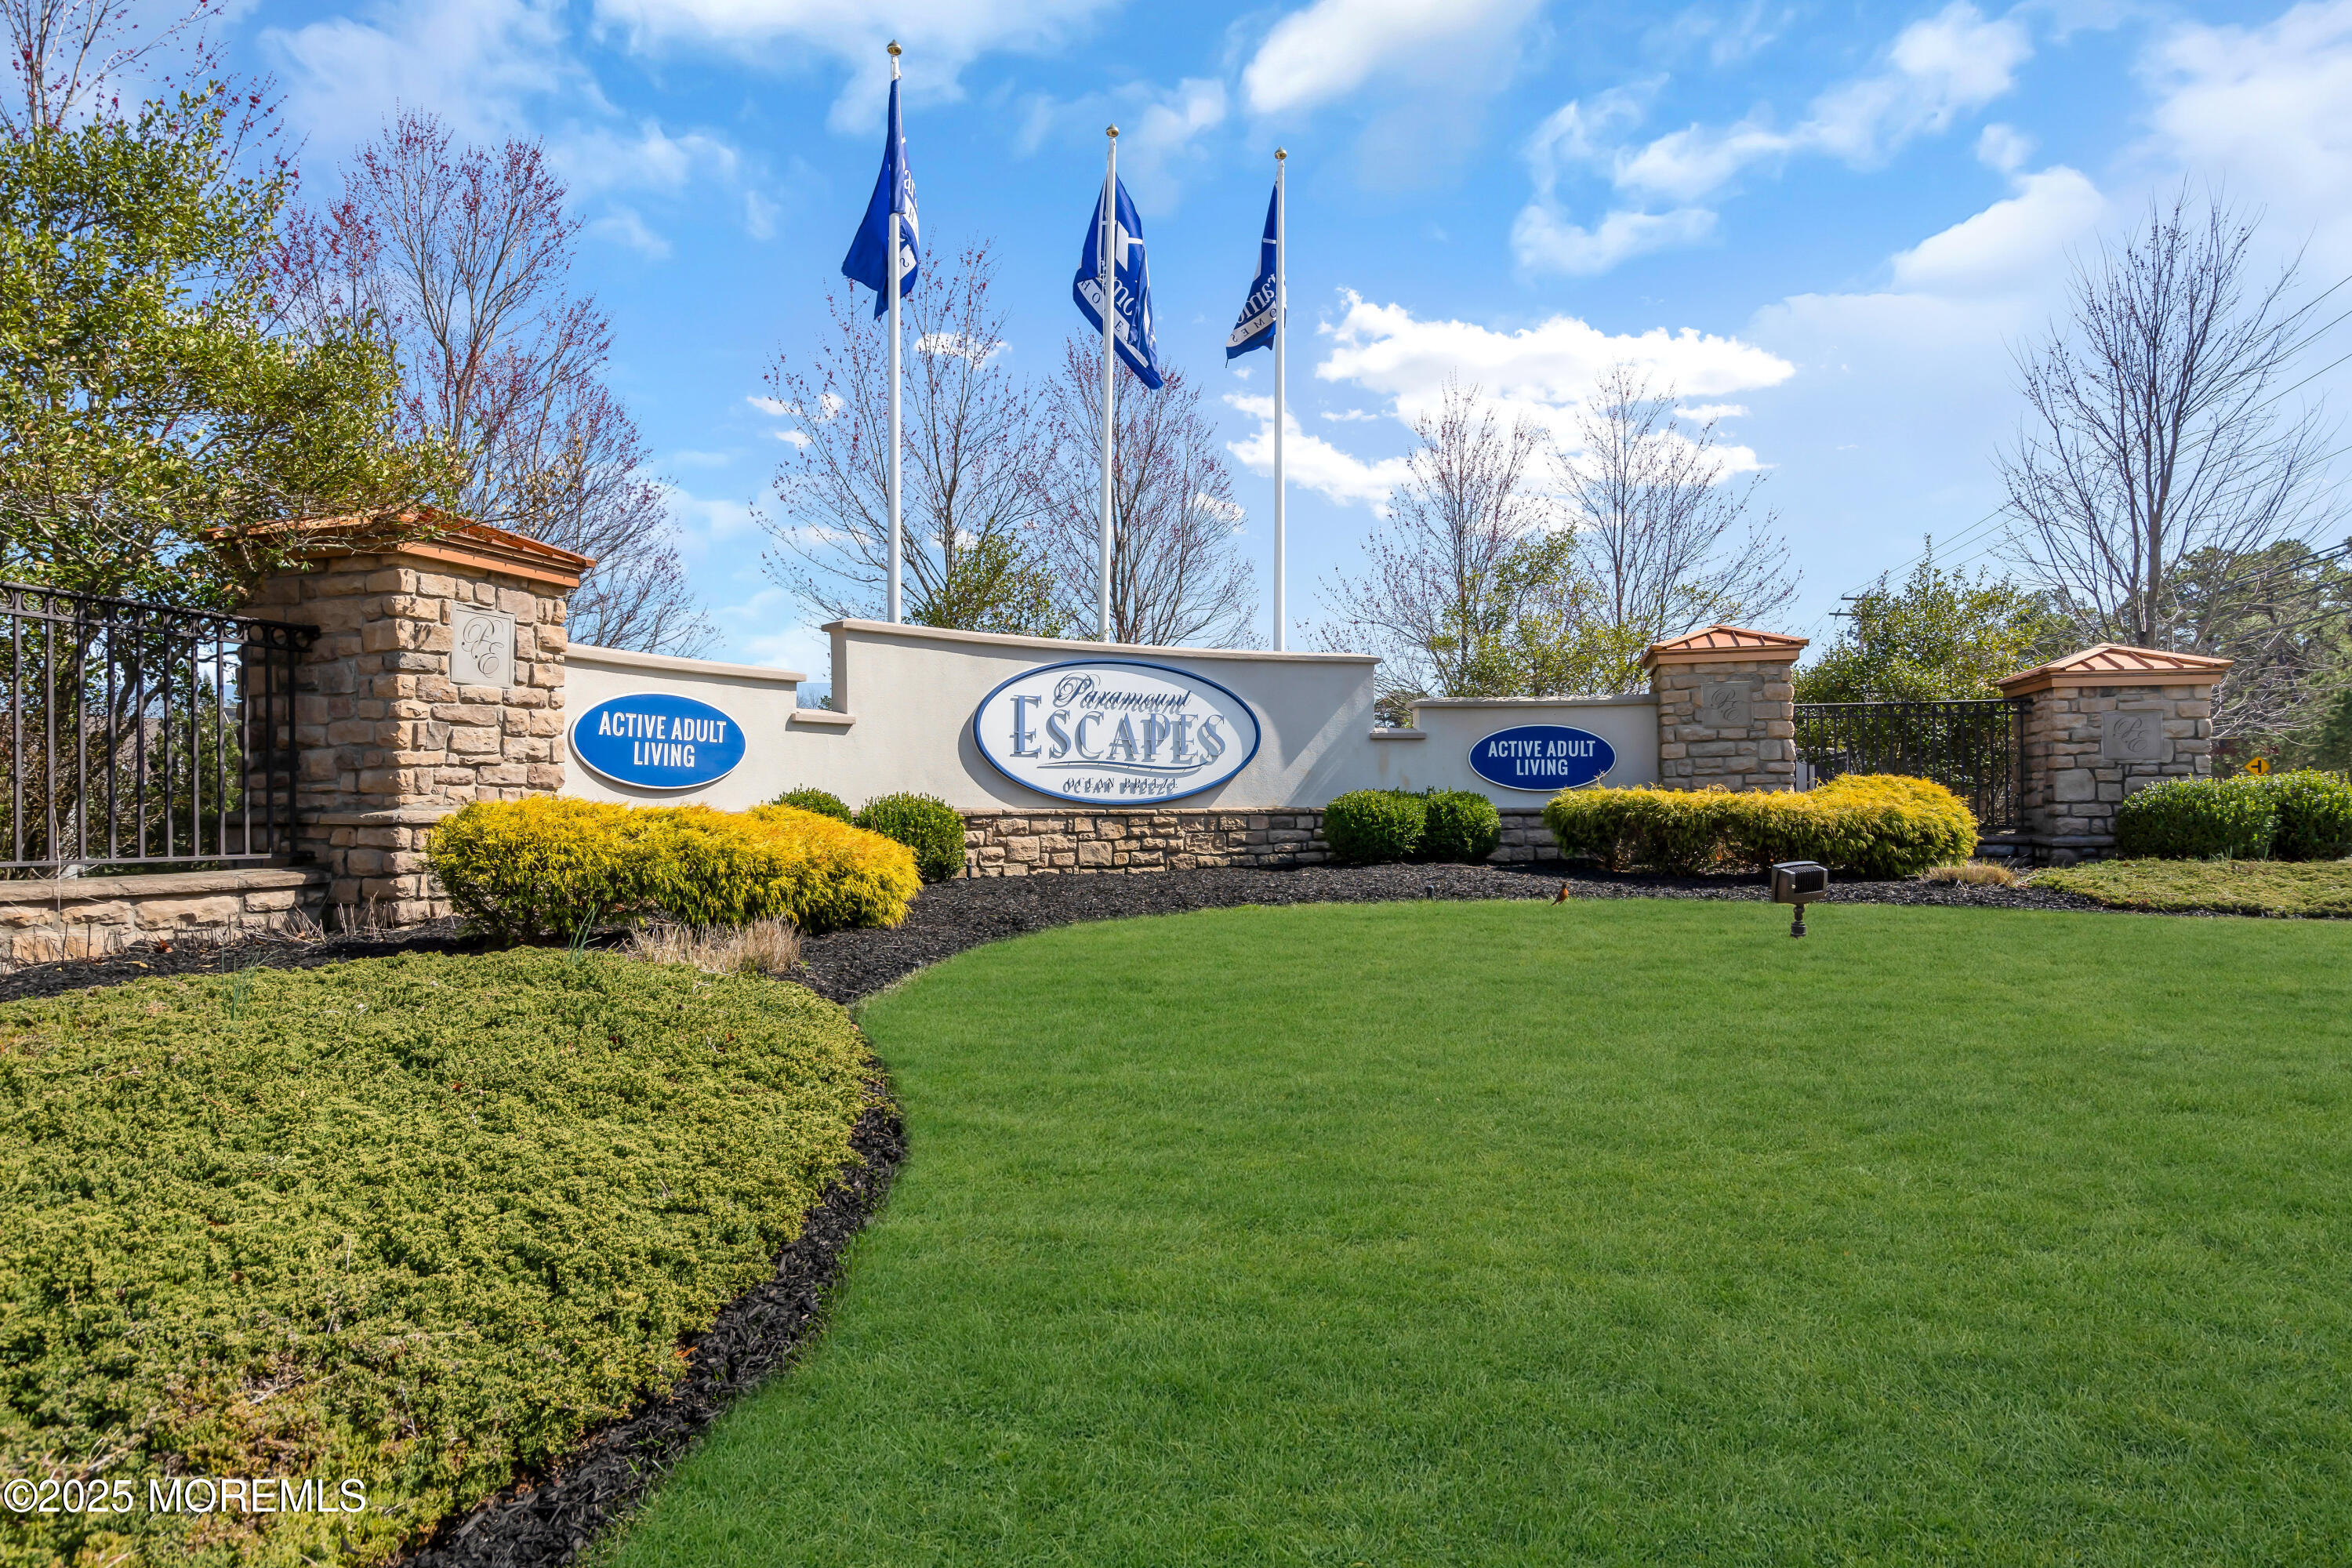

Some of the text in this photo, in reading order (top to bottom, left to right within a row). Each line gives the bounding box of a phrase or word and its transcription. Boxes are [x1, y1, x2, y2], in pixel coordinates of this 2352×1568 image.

[1054, 672, 1192, 708] Paramount
[598, 710, 728, 743] ACTIVE ADULT
[1011, 694, 1226, 758] ESCAPES
[633, 741, 696, 768] LIVING
[1488, 740, 1595, 757] ACTIVE ADULT
[1515, 758, 1569, 775] LIVING
[1065, 777, 1178, 790] OCEAN BREEZE
